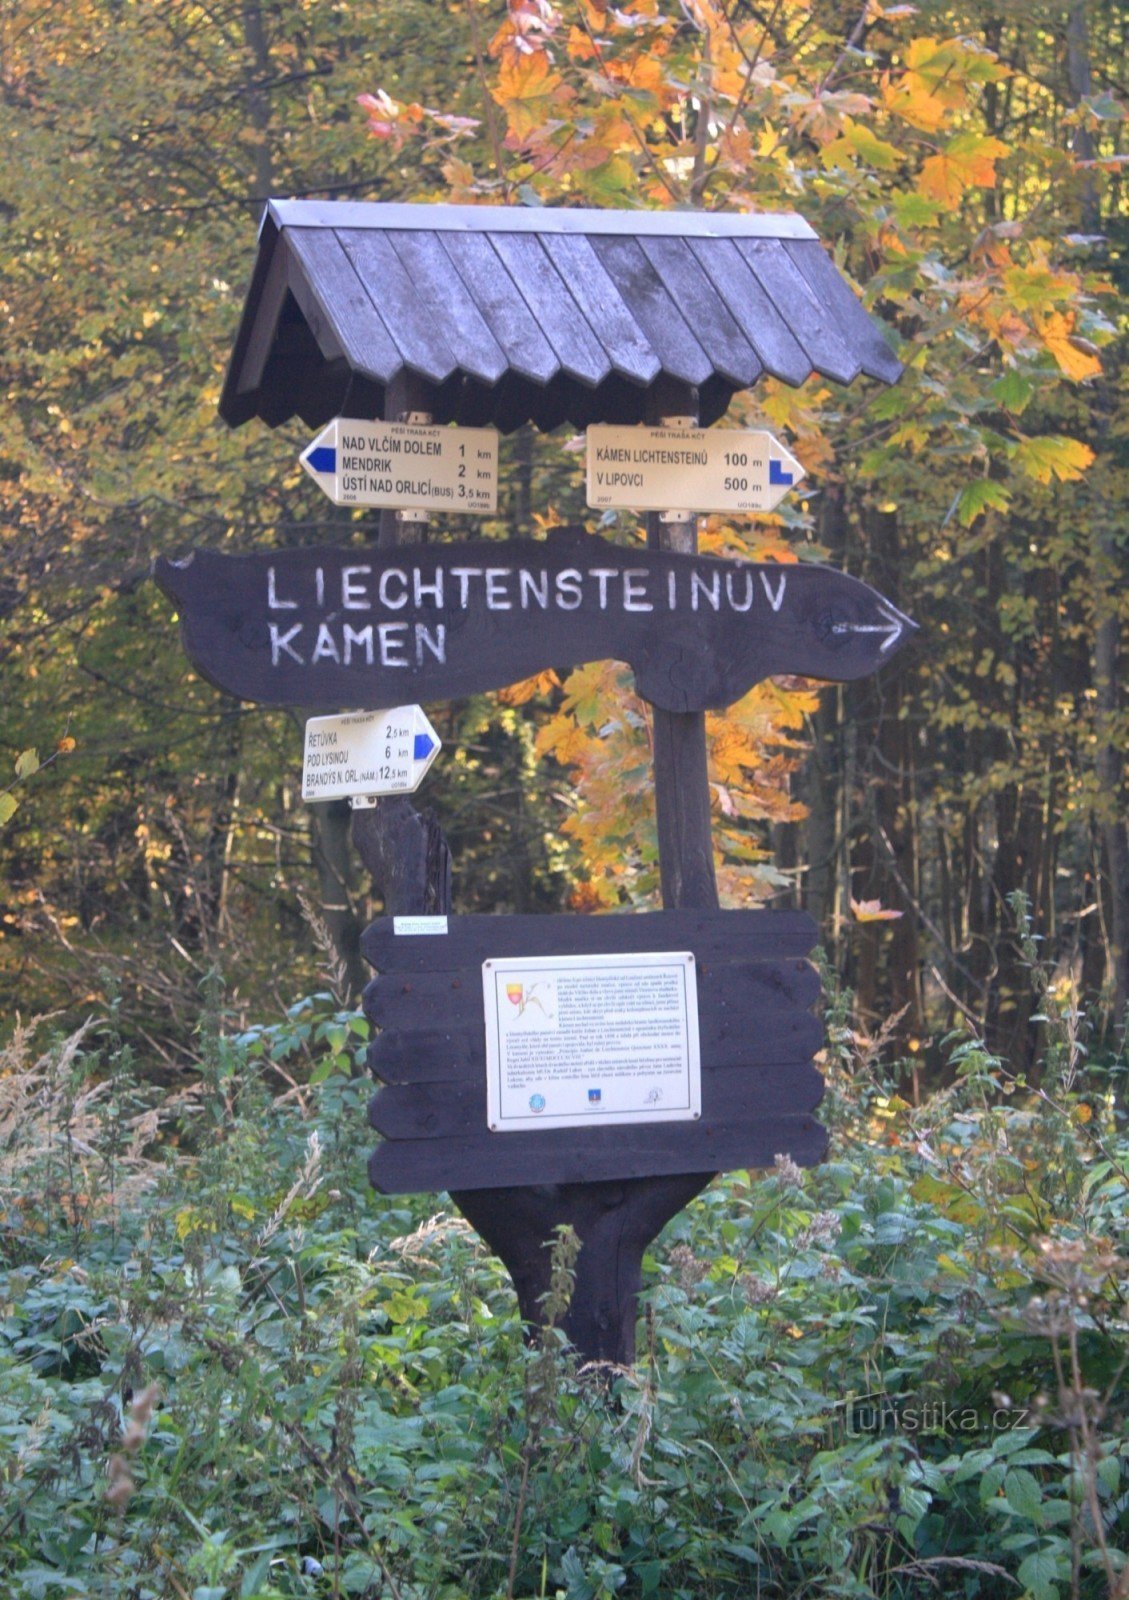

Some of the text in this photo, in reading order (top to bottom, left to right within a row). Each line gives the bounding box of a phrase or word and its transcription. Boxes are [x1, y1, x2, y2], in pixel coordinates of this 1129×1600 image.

[342, 436, 491, 460] NAD VLČÍM DOLEM 1 km
[596, 446, 631, 462] KÁMEN
[633, 449, 708, 466] LICHTENSTEINŮ
[723, 453, 747, 466] 100
[342, 457, 491, 479] MENDRIK 2 km
[342, 474, 367, 491] ÚSTÍ
[370, 479, 393, 493] NAD
[458, 484, 474, 499] 3,5
[476, 489, 490, 499] km
[597, 472, 762, 492] V LIPOVCI 500 m
[268, 612, 446, 666] KÁMEN
[308, 725, 409, 748] ŘETŮVKA 2,5 km
[307, 746, 408, 767] POD LYSINOU 6 km
[306, 769, 336, 787] BRANDÝS
[379, 766, 396, 780] 12,5
[398, 769, 408, 777] km
